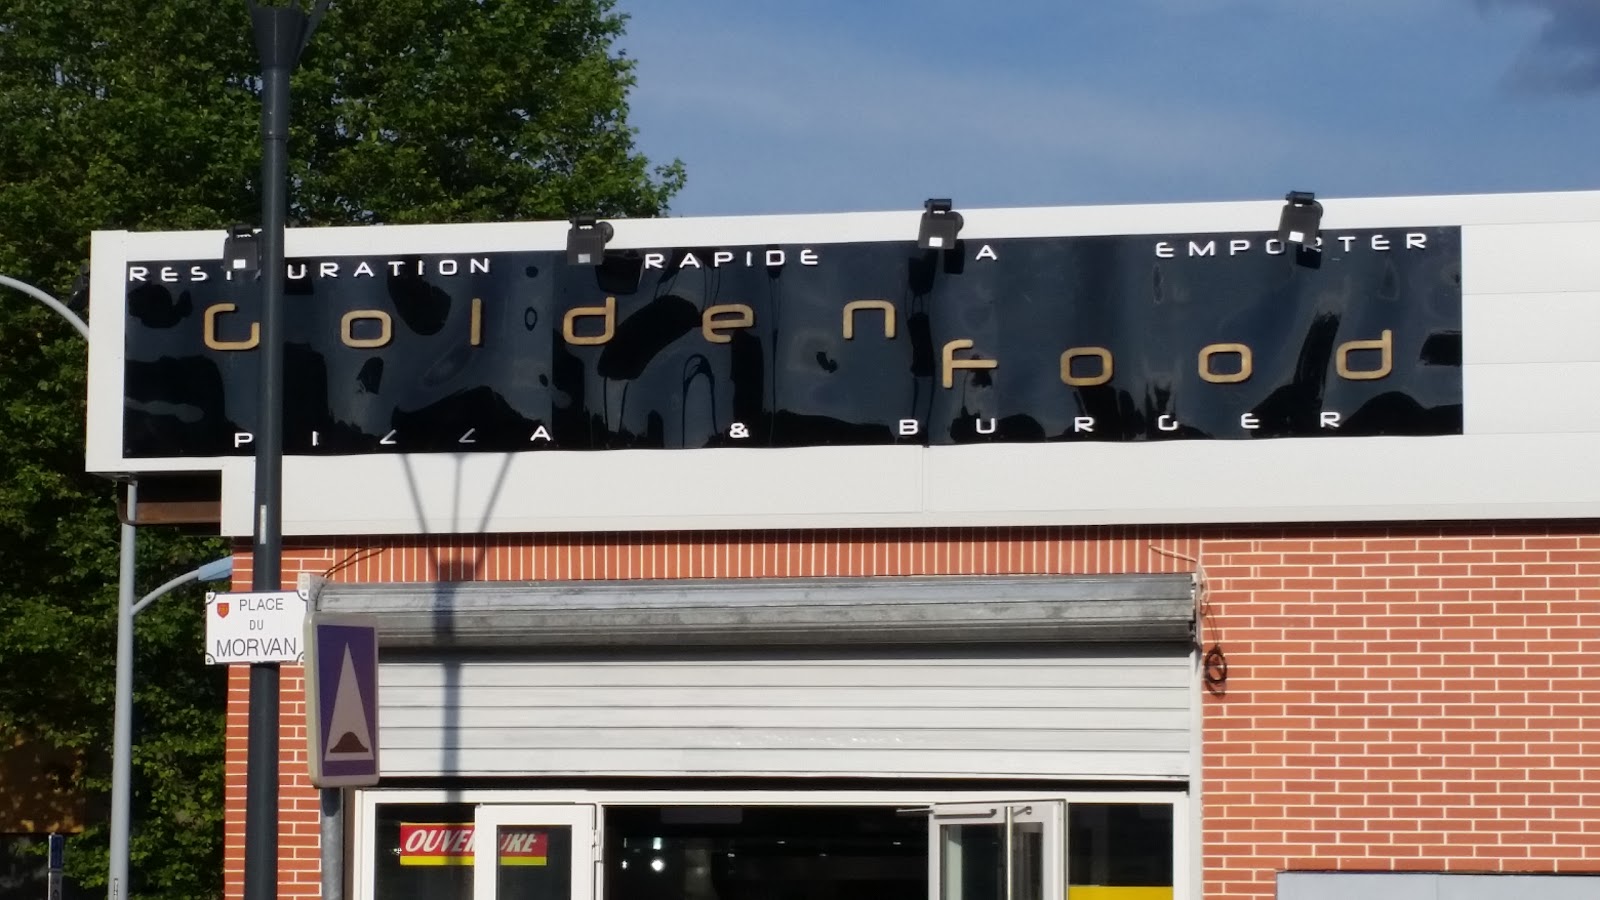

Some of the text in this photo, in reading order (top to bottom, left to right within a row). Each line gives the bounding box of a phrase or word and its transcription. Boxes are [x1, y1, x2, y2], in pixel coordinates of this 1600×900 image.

[644, 248, 819, 270] RAPIDE
[975, 244, 998, 261] A
[203, 297, 896, 351] Golden
[942, 329, 1393, 389] food
[729, 422, 750, 439] &
[899, 411, 1341, 436] BURGER
[239, 598, 284, 611] PLACE
[249, 619, 265, 631] DU
[216, 637, 297, 657] MORVAN
